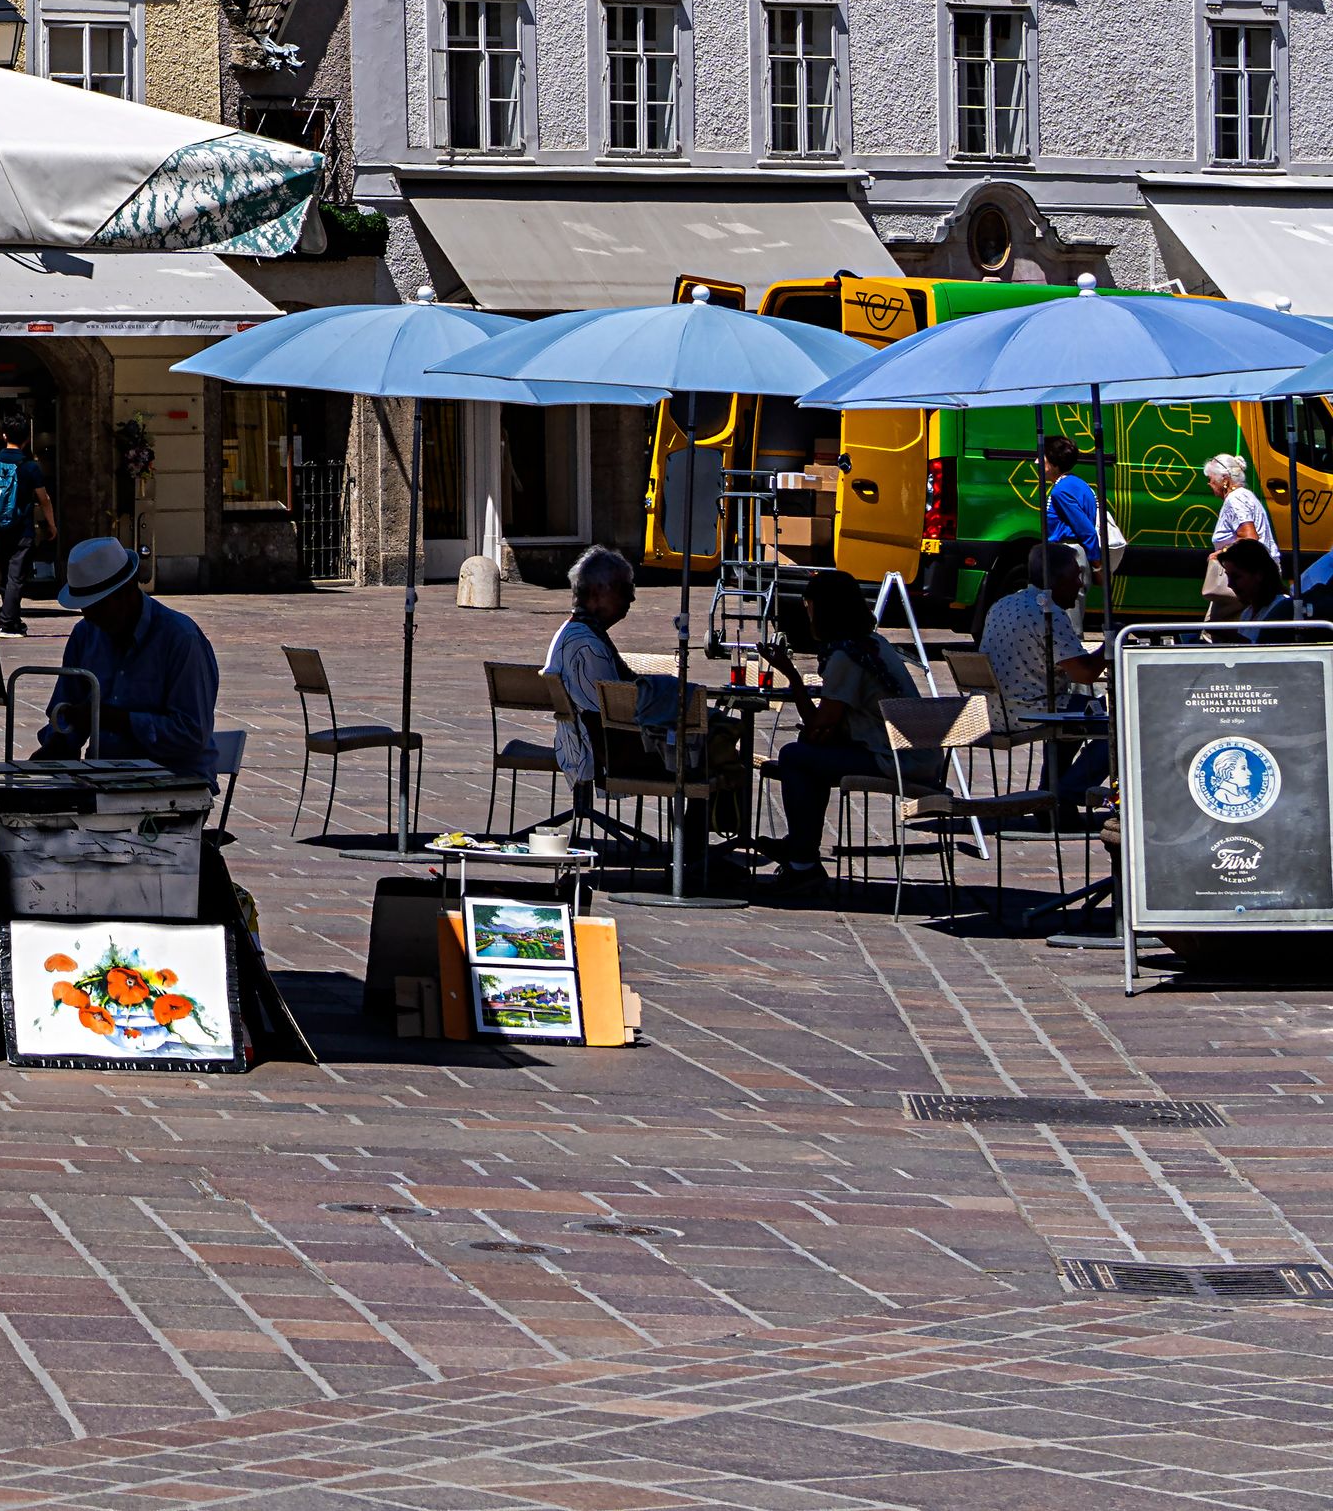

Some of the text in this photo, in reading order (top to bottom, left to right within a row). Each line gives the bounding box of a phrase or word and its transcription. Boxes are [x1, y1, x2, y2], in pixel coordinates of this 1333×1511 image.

[1210, 684, 1232, 692] ERST-
[1192, 691, 1260, 699] ALLEINERZEUGER
[1199, 769, 1269, 811] ORIGINAL MOZARTKUGEL
[1211, 848, 1261, 870] Fürst
[1219, 874, 1257, 883] SALZBURG
